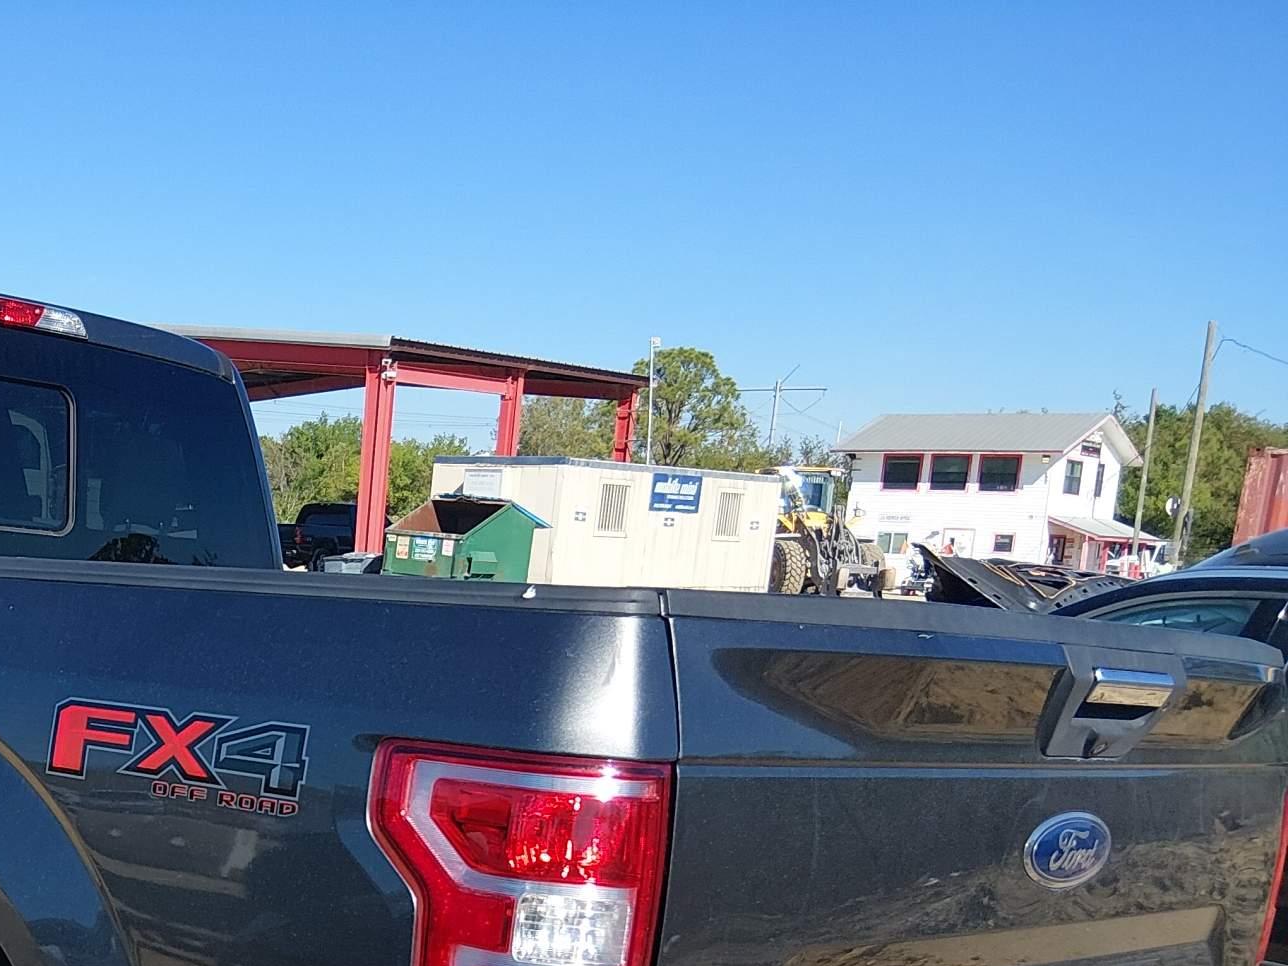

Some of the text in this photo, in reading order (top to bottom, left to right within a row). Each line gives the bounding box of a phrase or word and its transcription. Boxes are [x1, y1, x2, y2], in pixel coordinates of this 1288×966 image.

[46, 697, 311, 801] FX4
[151, 780, 299, 817] OFF ROAD
[1048, 828, 1100, 872] Ford
